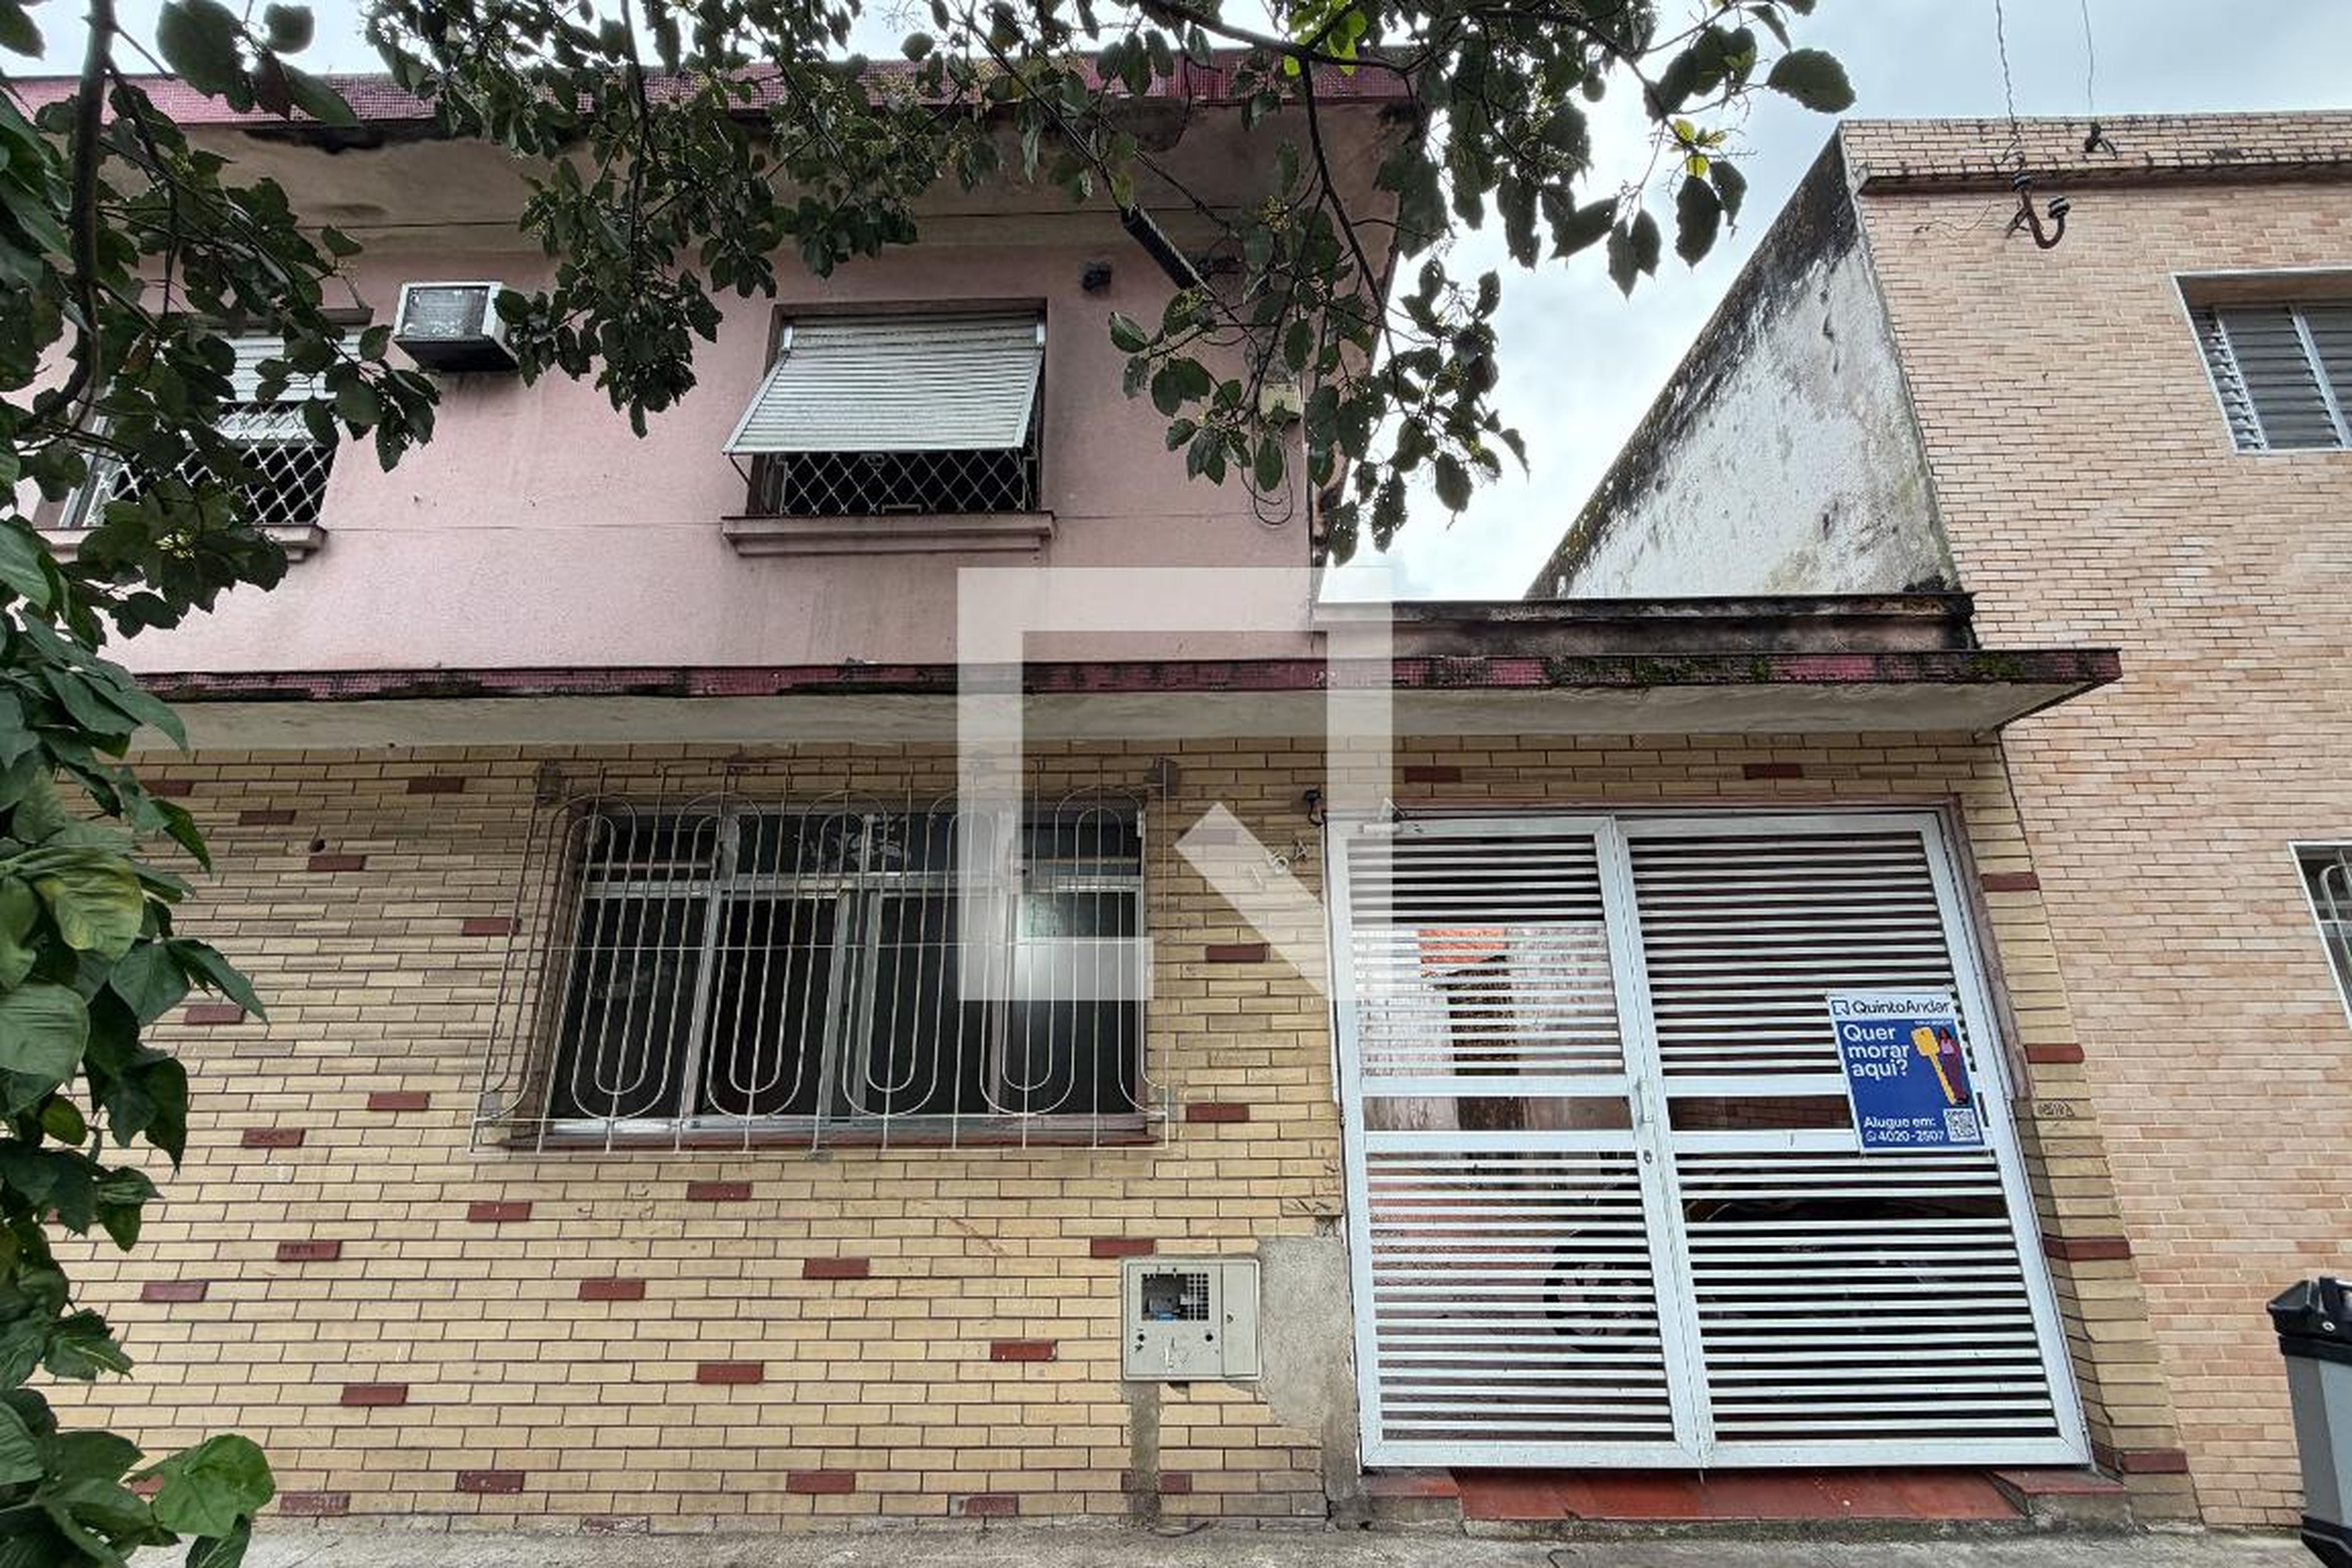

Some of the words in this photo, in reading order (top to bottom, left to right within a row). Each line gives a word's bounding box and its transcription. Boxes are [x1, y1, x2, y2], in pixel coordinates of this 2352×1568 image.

[1852, 1000, 1950, 1014] QuintoAndar
[1843, 1024, 1896, 1042] Quer
[1847, 1045, 1909, 1058] morar
[1851, 1058, 1908, 1080] aqui?
[1864, 1116, 1910, 1129] Alugue
[1912, 1118, 1936, 1127] em:
